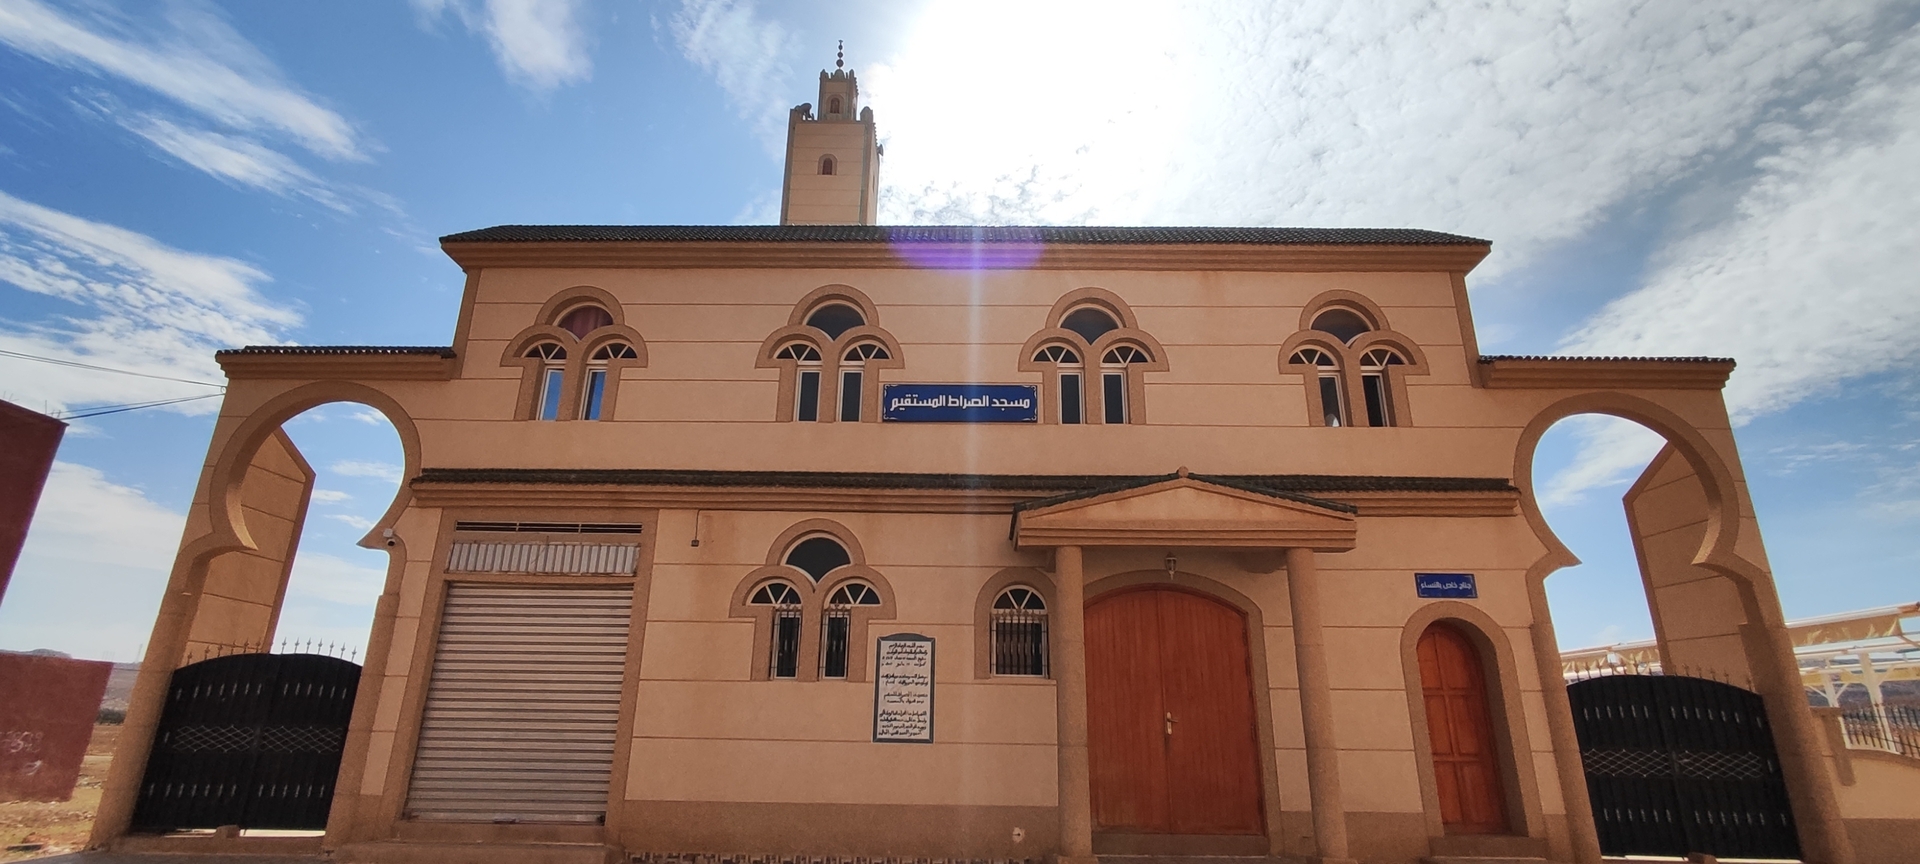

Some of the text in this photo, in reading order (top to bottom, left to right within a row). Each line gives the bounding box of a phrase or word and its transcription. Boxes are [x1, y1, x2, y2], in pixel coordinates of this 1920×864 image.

[889, 394, 1030, 411] مسجد الصراط المستقيم
[1420, 581, 1442, 589] بالنساء
[1443, 581, 1458, 590] خاص
